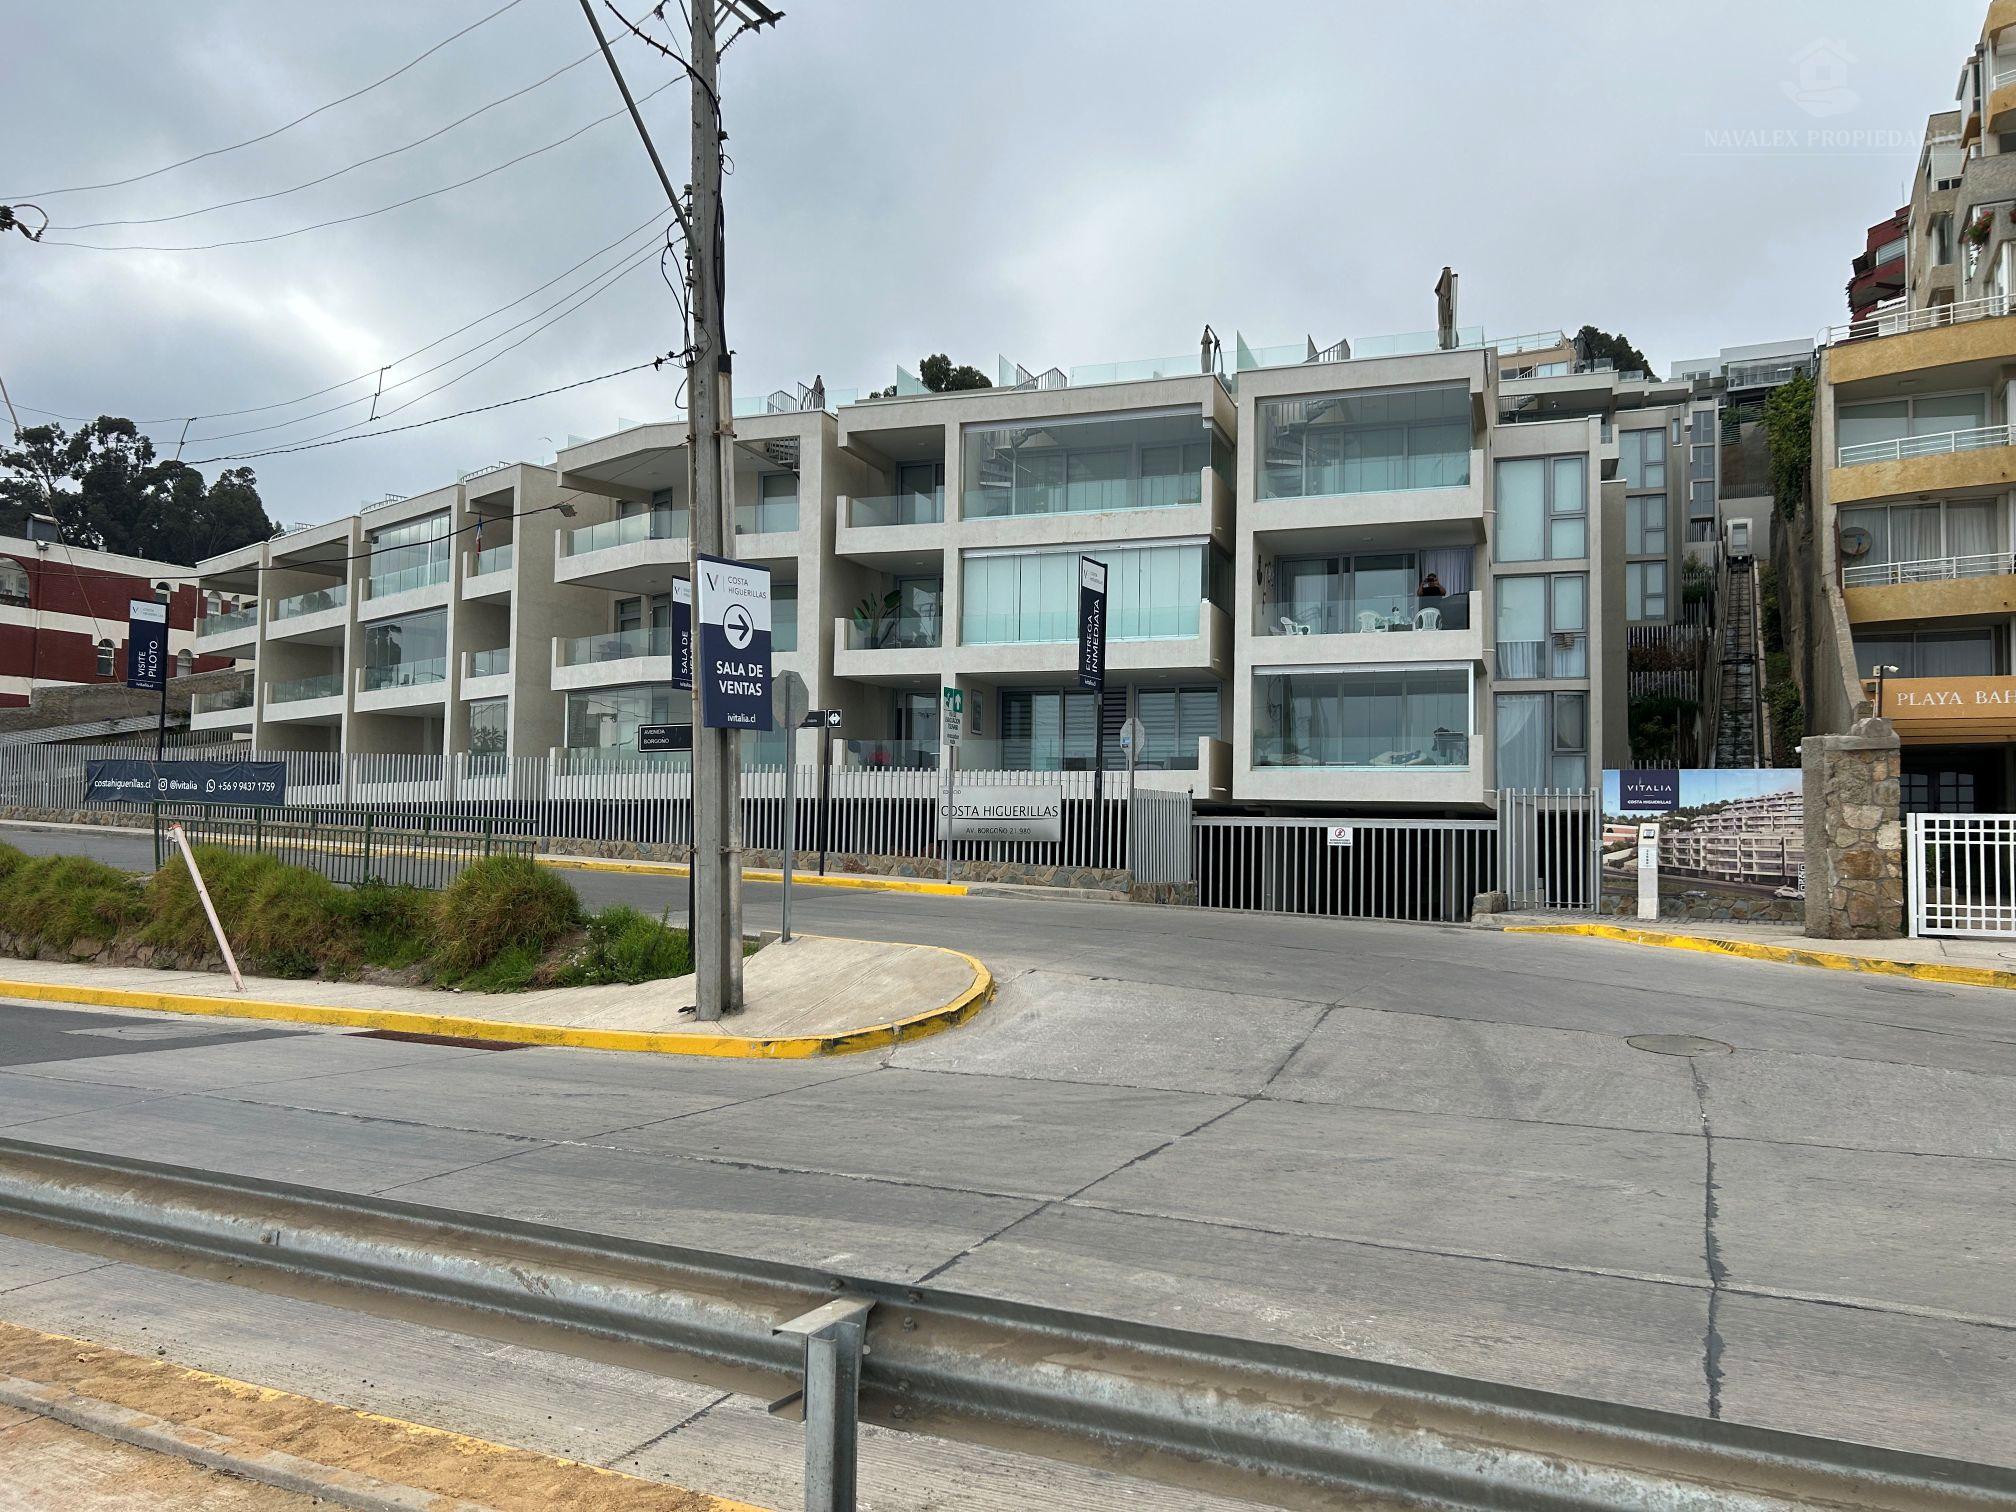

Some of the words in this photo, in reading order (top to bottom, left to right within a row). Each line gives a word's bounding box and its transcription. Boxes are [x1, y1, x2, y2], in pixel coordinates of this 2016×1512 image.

[727, 576, 749, 586] COSTA
[729, 587, 767, 599] HIGUERILLAS
[681, 631, 688, 645] DE
[1085, 614, 1093, 671] ENTREGA
[1092, 599, 1100, 673] INMEDIATA
[138, 651, 146, 677] VISITE
[148, 640, 158, 677] PILOTO
[716, 660, 746, 676] SALA
[748, 663, 763, 678] DE
[719, 679, 762, 696] VENTAS
[1896, 691, 1963, 706] PLAYA
[727, 712, 756, 723] ivitalia.cl
[94, 778, 151, 790] costahiguerillas.cl
[169, 780, 198, 790] @ivitalia
[218, 781, 231, 791] +56
[232, 781, 238, 790] 9
[257, 782, 276, 792] 1759
[941, 805, 979, 817] COSTA
[983, 805, 1058, 817] HIGUERILLAS
